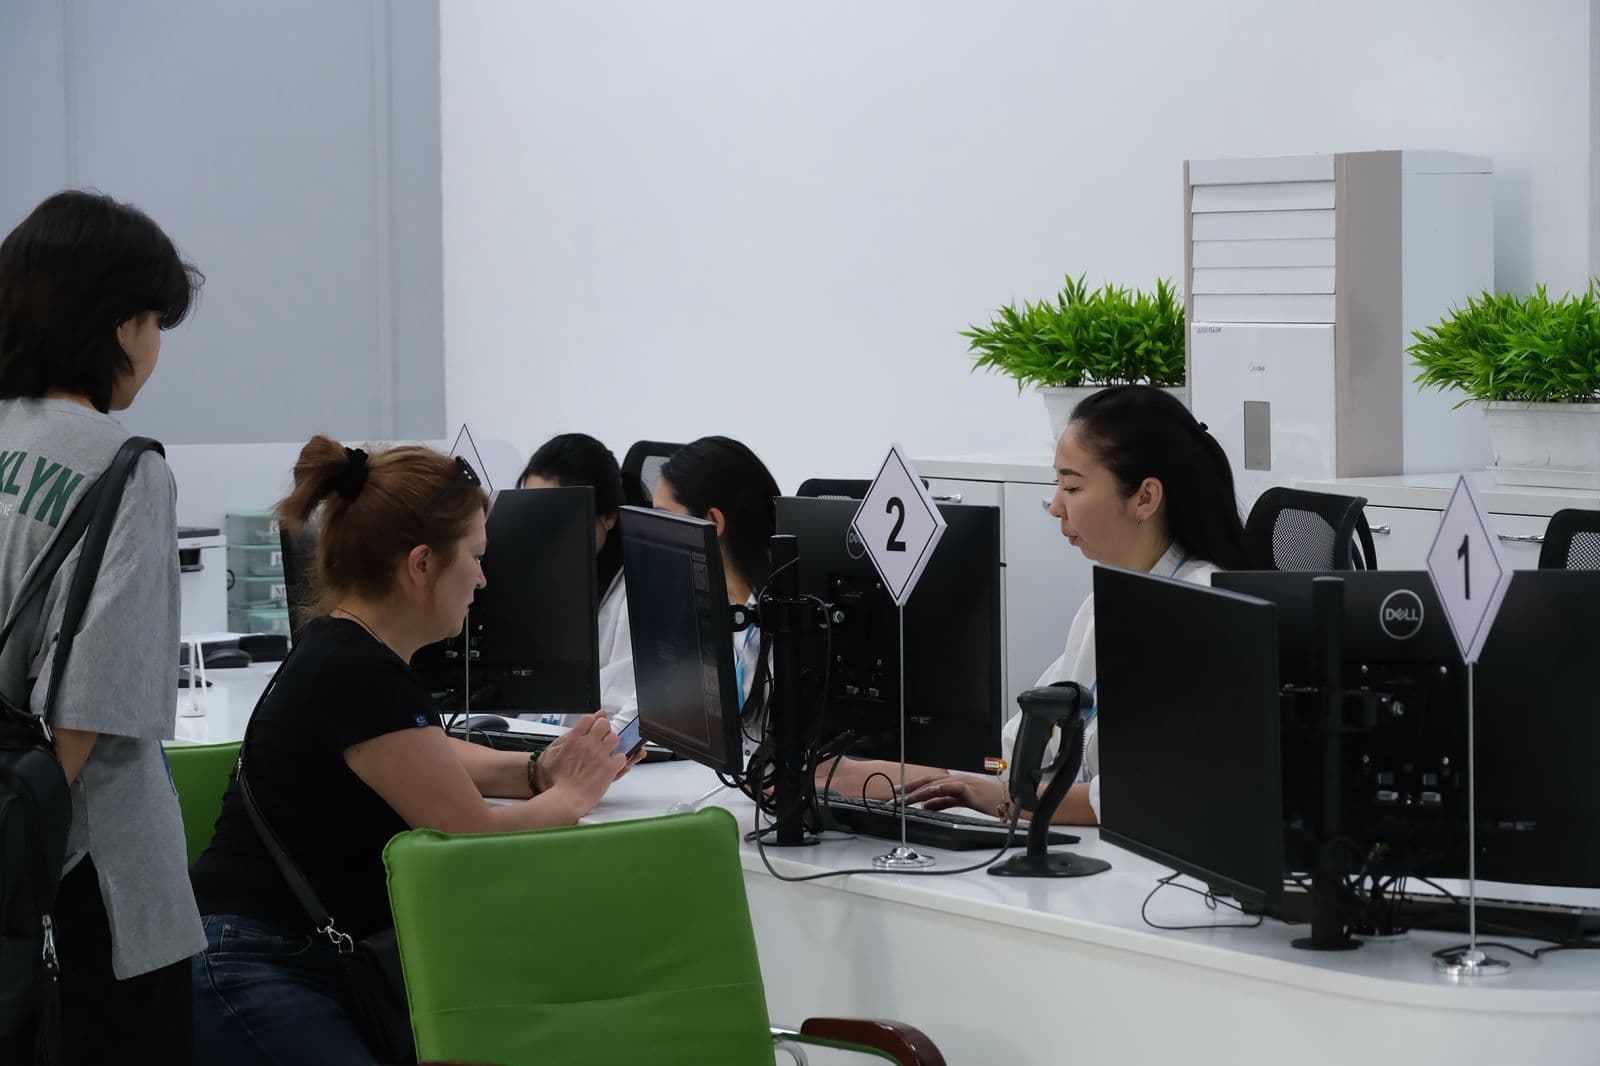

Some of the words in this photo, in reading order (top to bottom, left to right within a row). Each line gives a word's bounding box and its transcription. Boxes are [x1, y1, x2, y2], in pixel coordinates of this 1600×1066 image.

[886, 496, 906, 552] 2
[1457, 534, 1471, 600] 1
[1385, 607, 1419, 621] DELL
